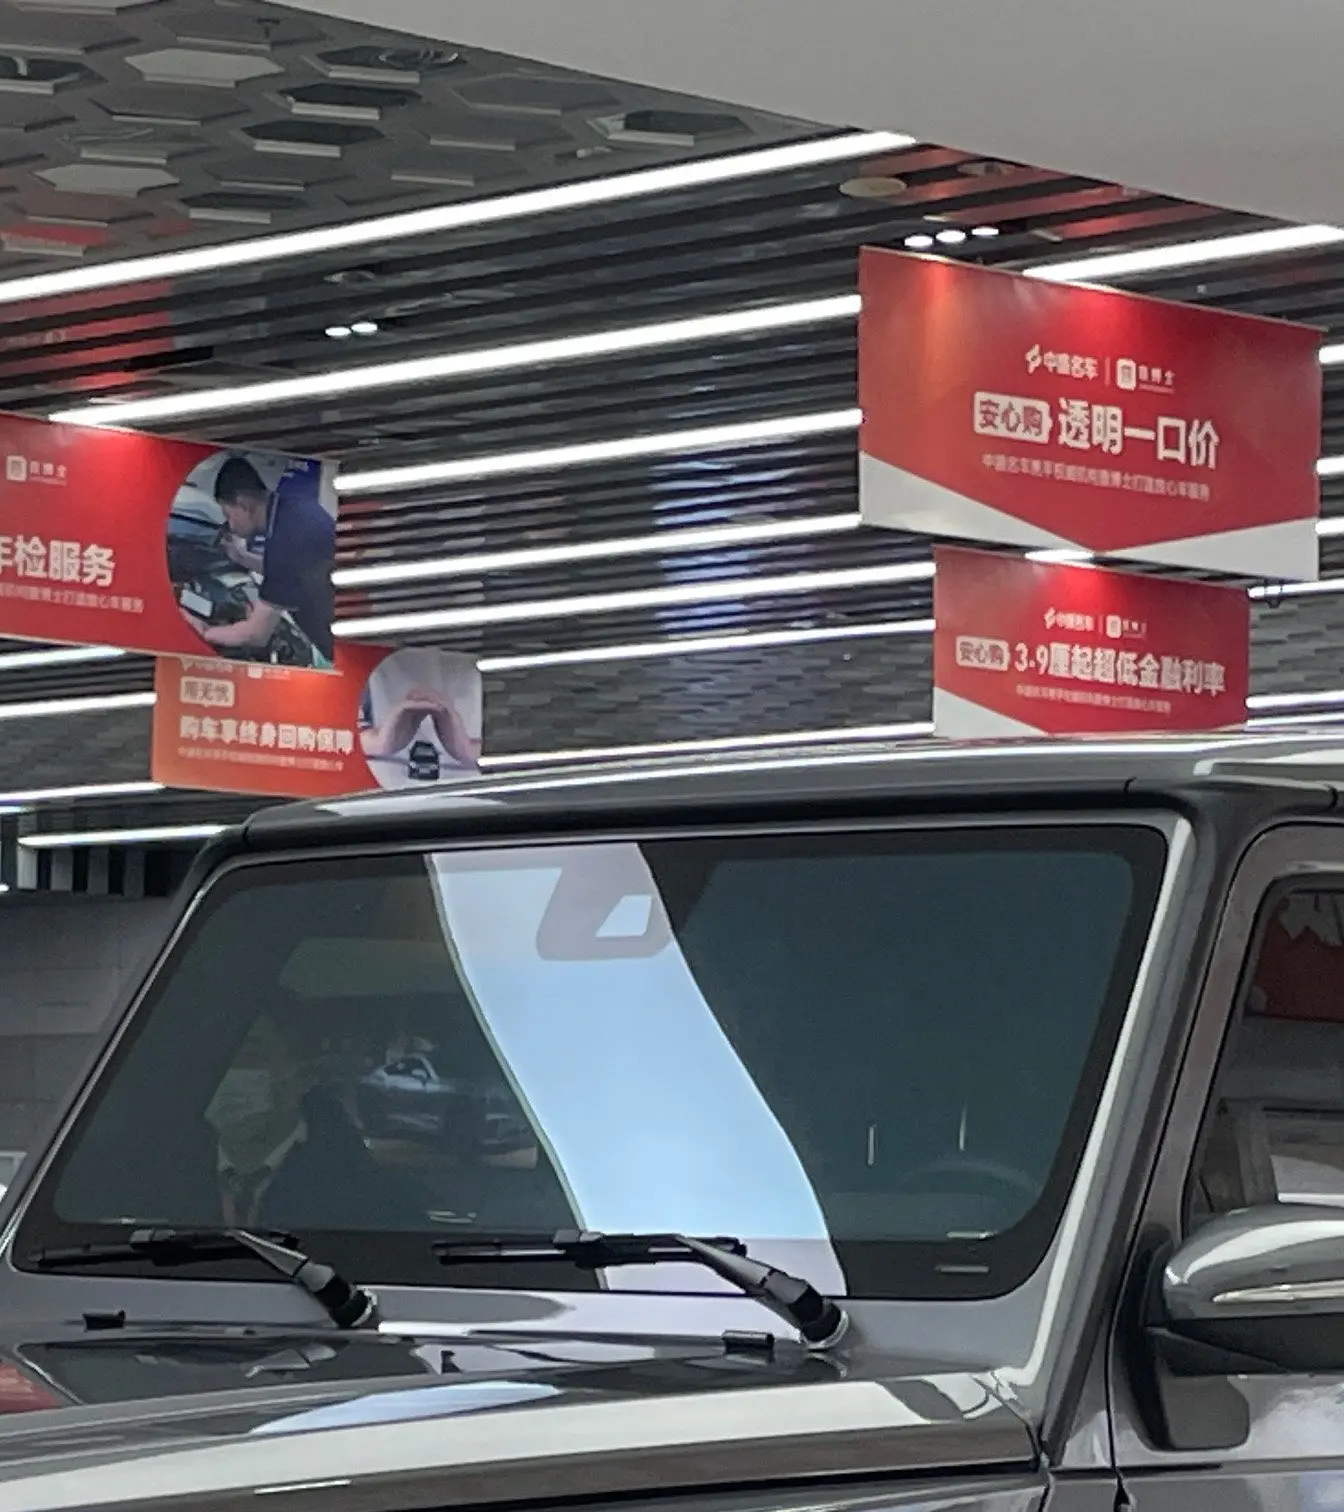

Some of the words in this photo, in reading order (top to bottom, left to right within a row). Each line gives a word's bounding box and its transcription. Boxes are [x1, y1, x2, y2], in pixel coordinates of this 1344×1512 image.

[979, 399, 1043, 437] 安心购
[1058, 398, 1220, 469] 透明一口价
